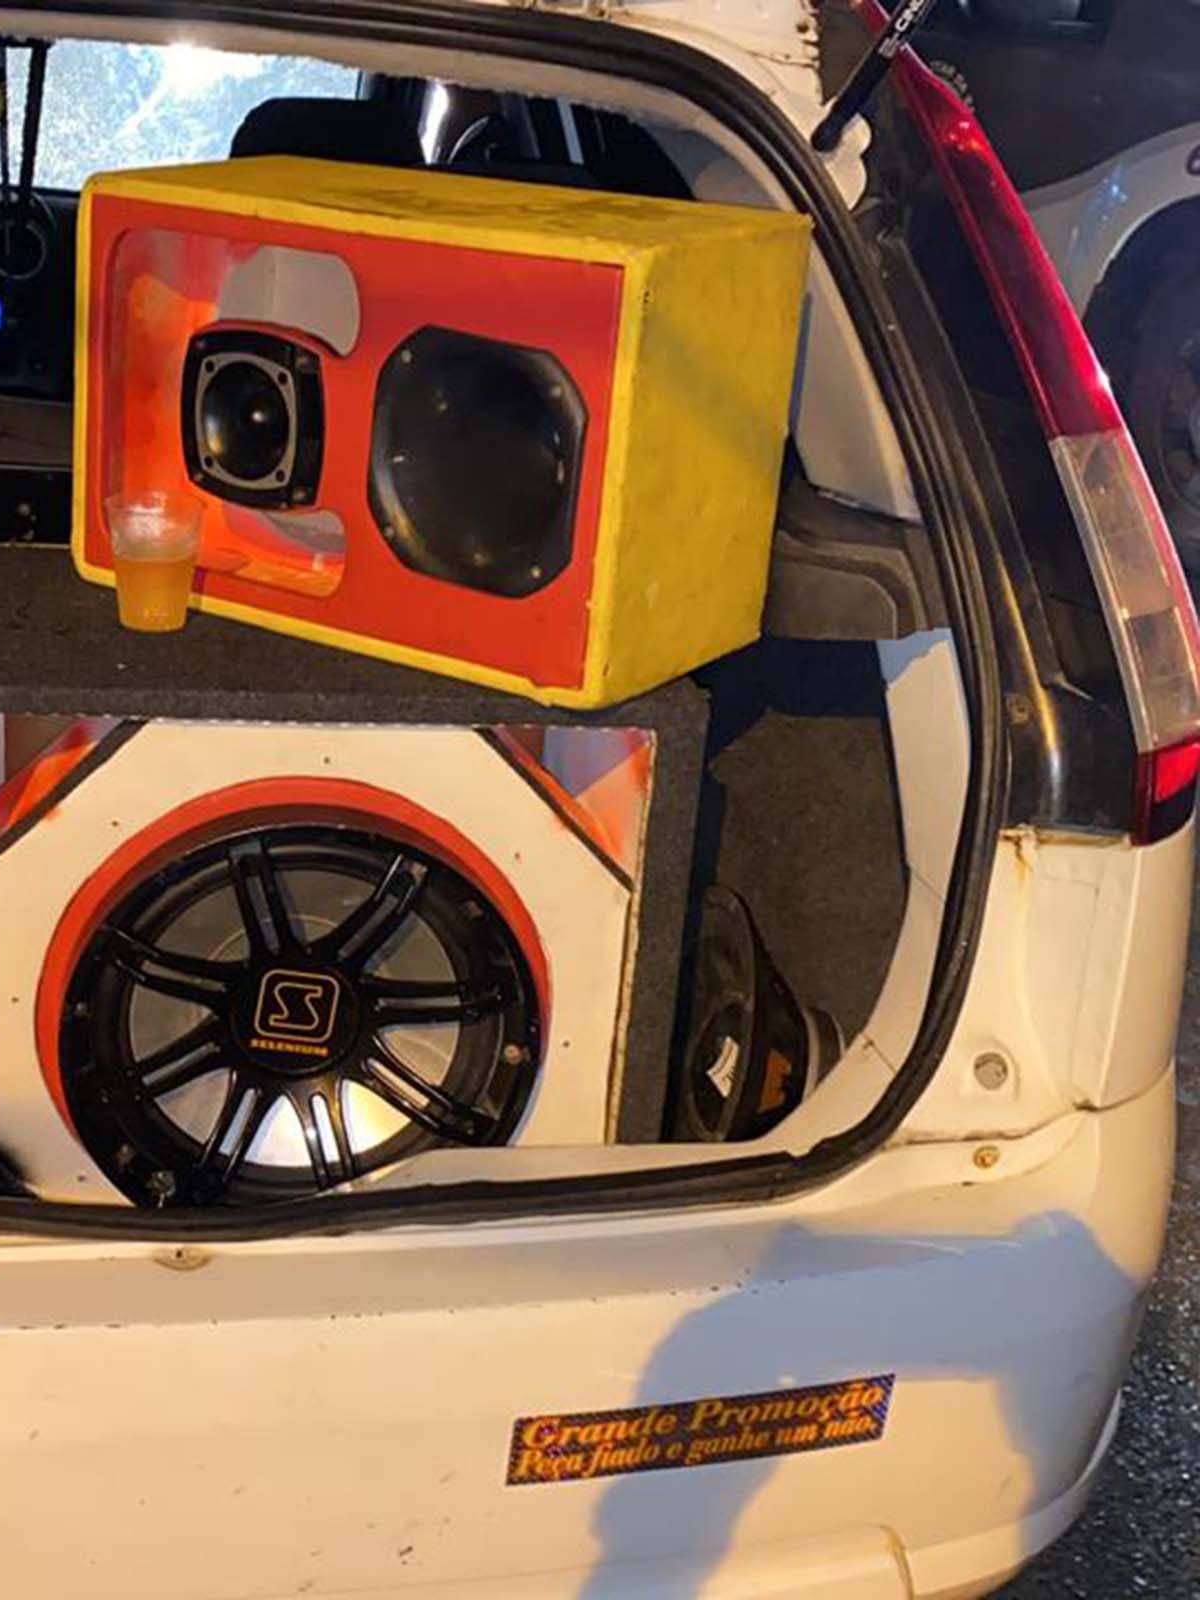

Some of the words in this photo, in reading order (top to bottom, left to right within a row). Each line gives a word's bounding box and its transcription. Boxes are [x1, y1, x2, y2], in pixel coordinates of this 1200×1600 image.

[522, 1410, 677, 1448] Grande
[688, 1383, 883, 1430] Promoção
[516, 1448, 583, 1482] Peça
[580, 1437, 659, 1478] fiado
[685, 1426, 769, 1466] ganhe
[774, 1423, 819, 1445] um
